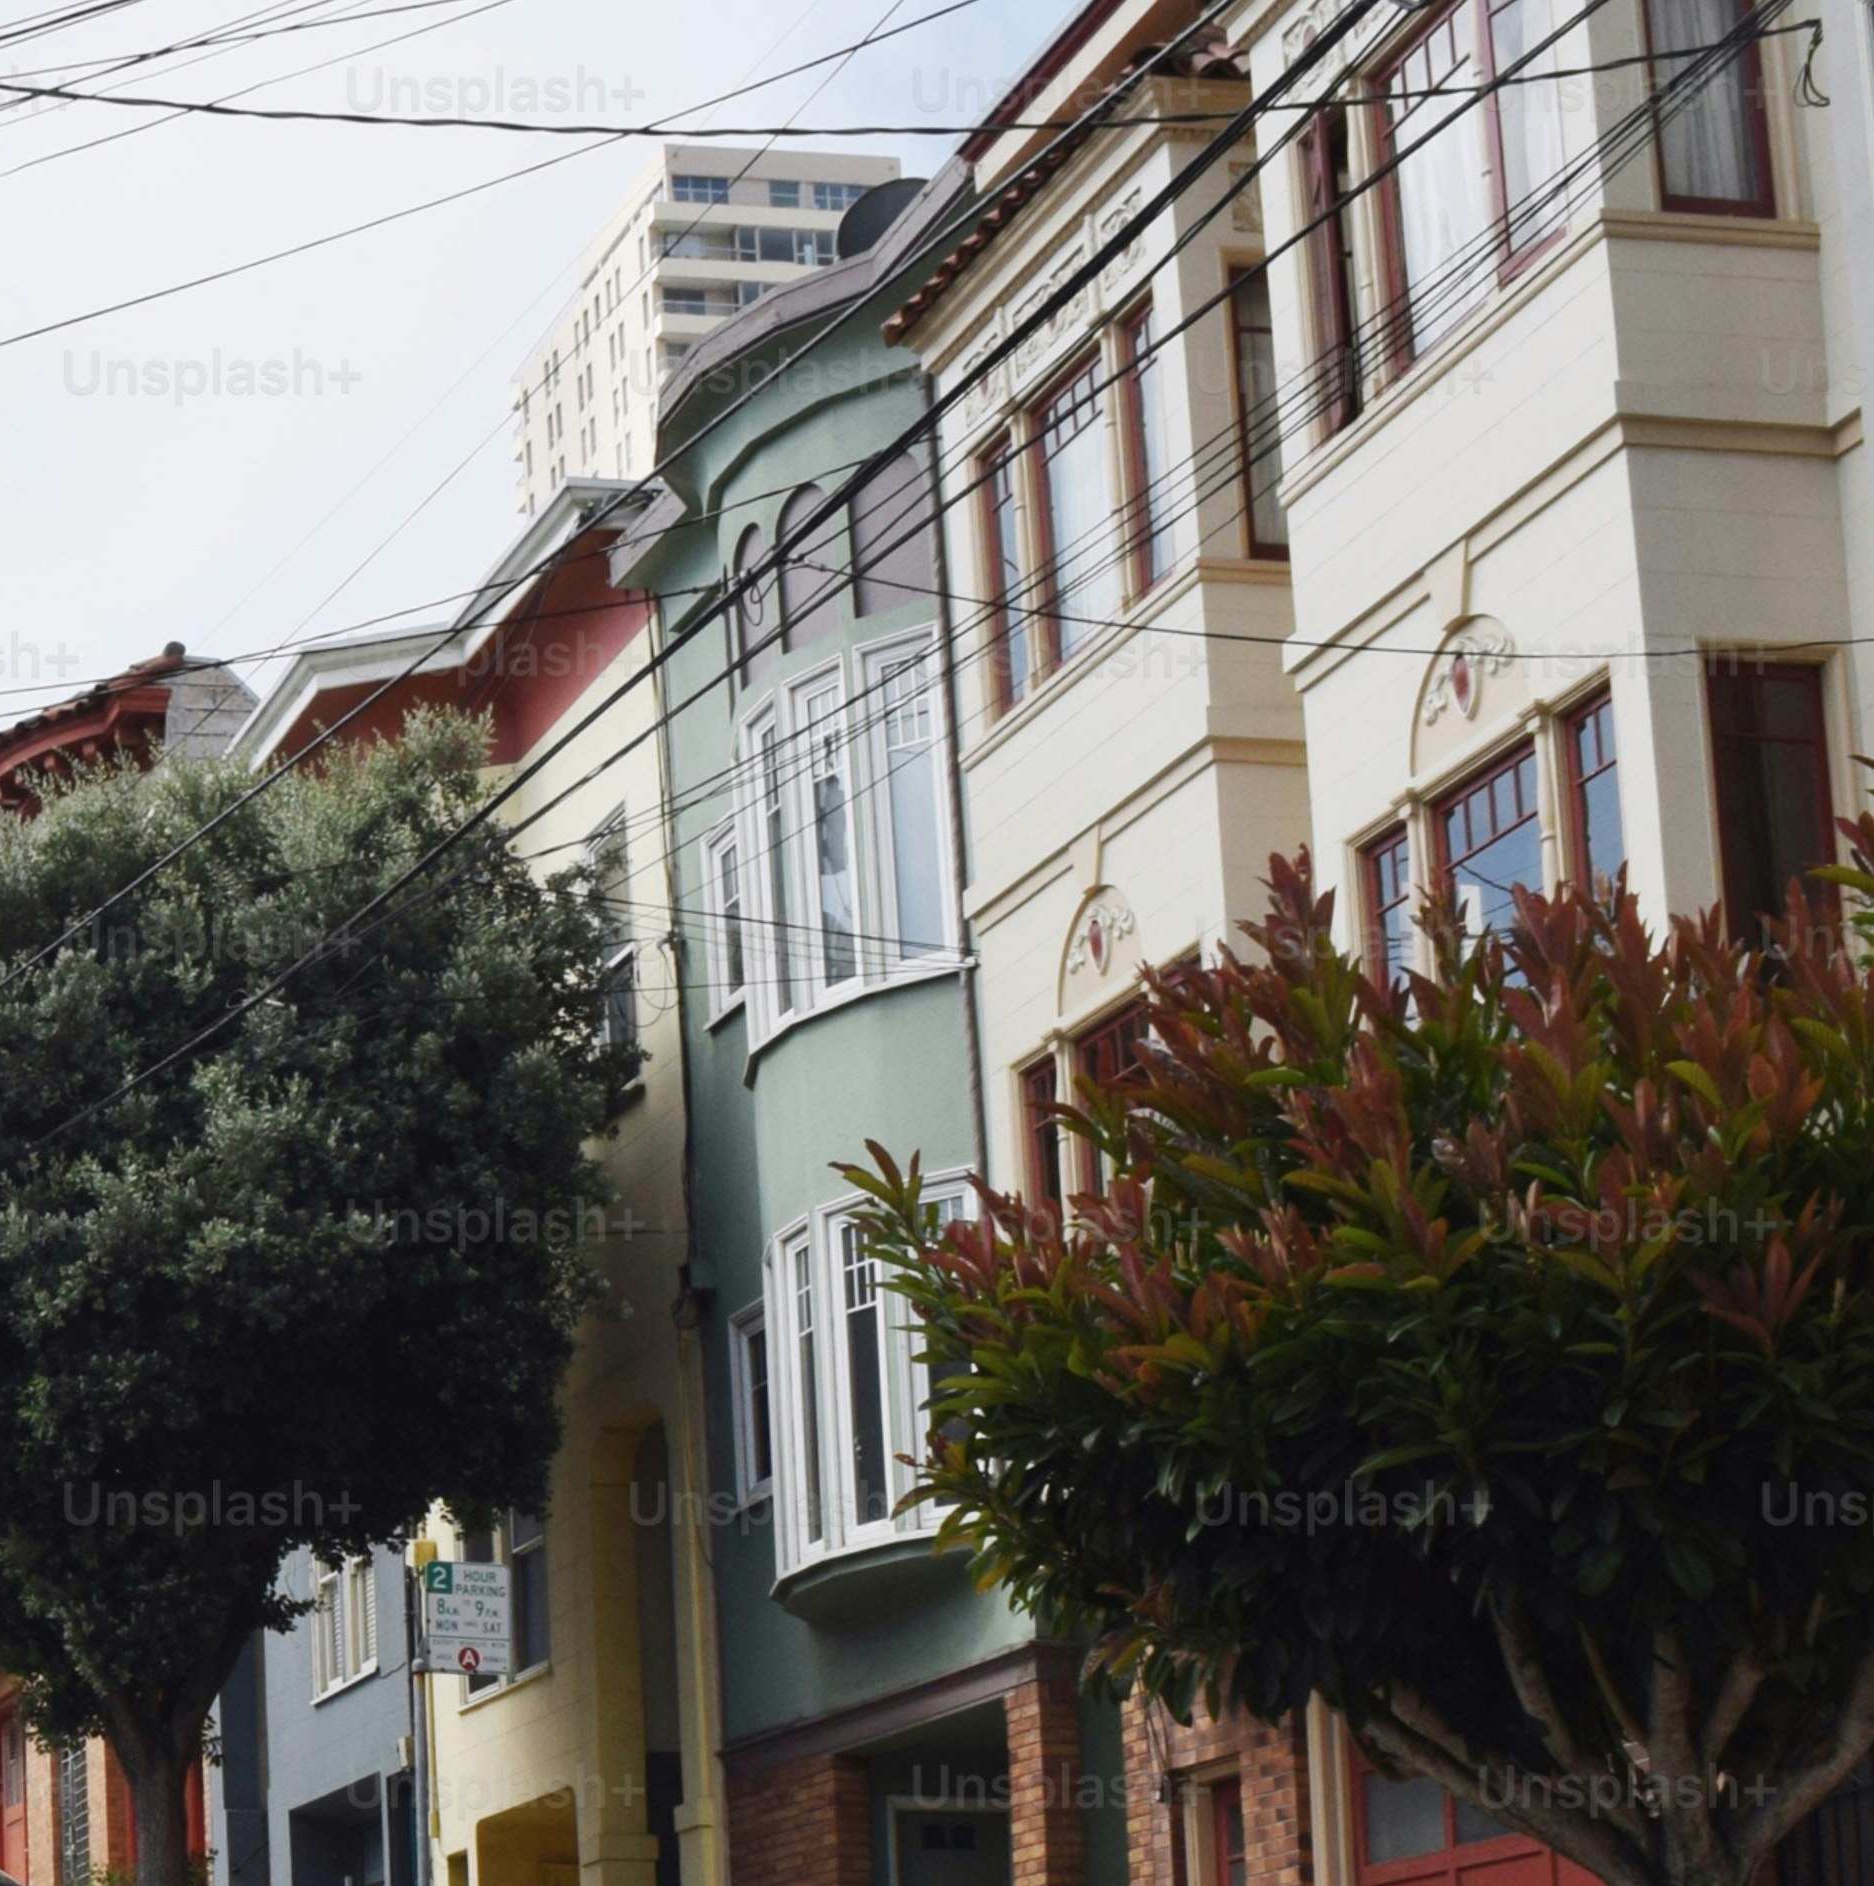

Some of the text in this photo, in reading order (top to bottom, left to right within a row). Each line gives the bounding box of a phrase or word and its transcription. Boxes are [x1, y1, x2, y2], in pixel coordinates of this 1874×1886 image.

[433, 1566, 496, 1588] 2 HOUR
[455, 1584, 507, 1598] PARKING
[435, 1620, 458, 1632] MON
[482, 1622, 501, 1634] SAT
[462, 1649, 476, 1666] A
